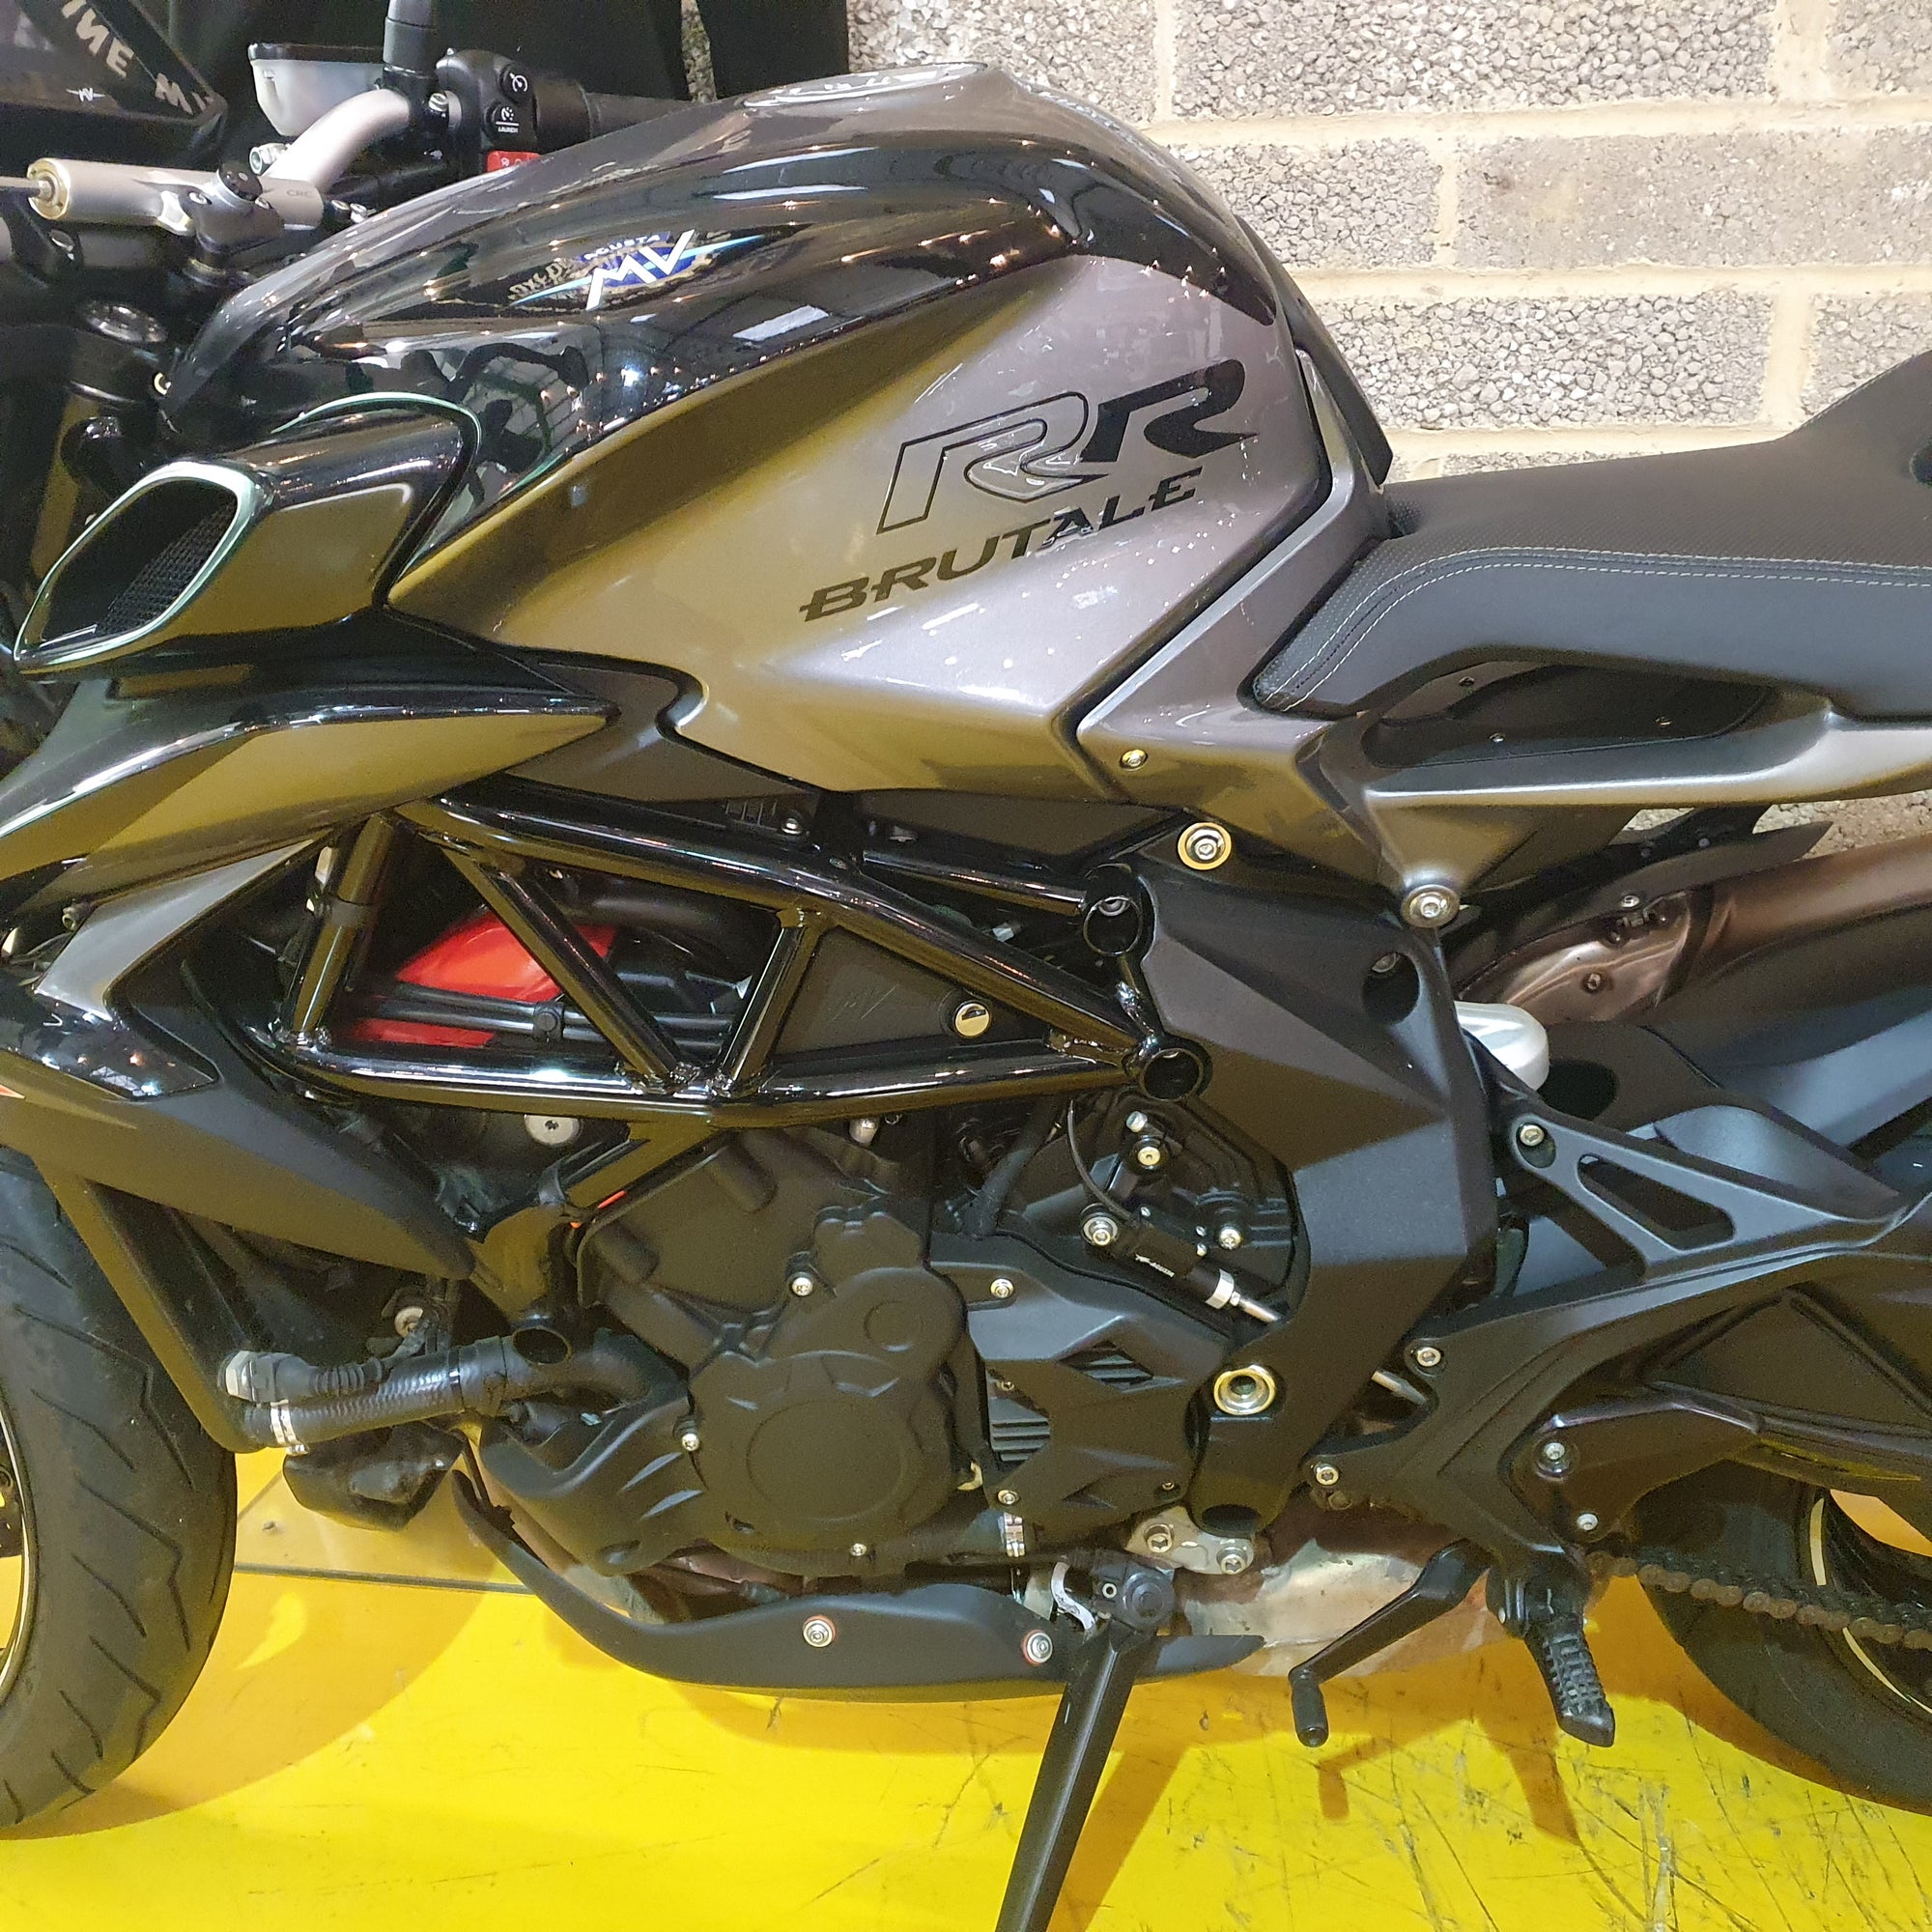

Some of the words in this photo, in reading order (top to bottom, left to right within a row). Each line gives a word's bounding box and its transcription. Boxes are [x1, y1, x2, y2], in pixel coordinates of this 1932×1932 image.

[583, 234, 661, 261] AGUSTA
[585, 229, 696, 311] MV
[875, 358, 1260, 535] RR
[798, 467, 1203, 622] BRUTALE
